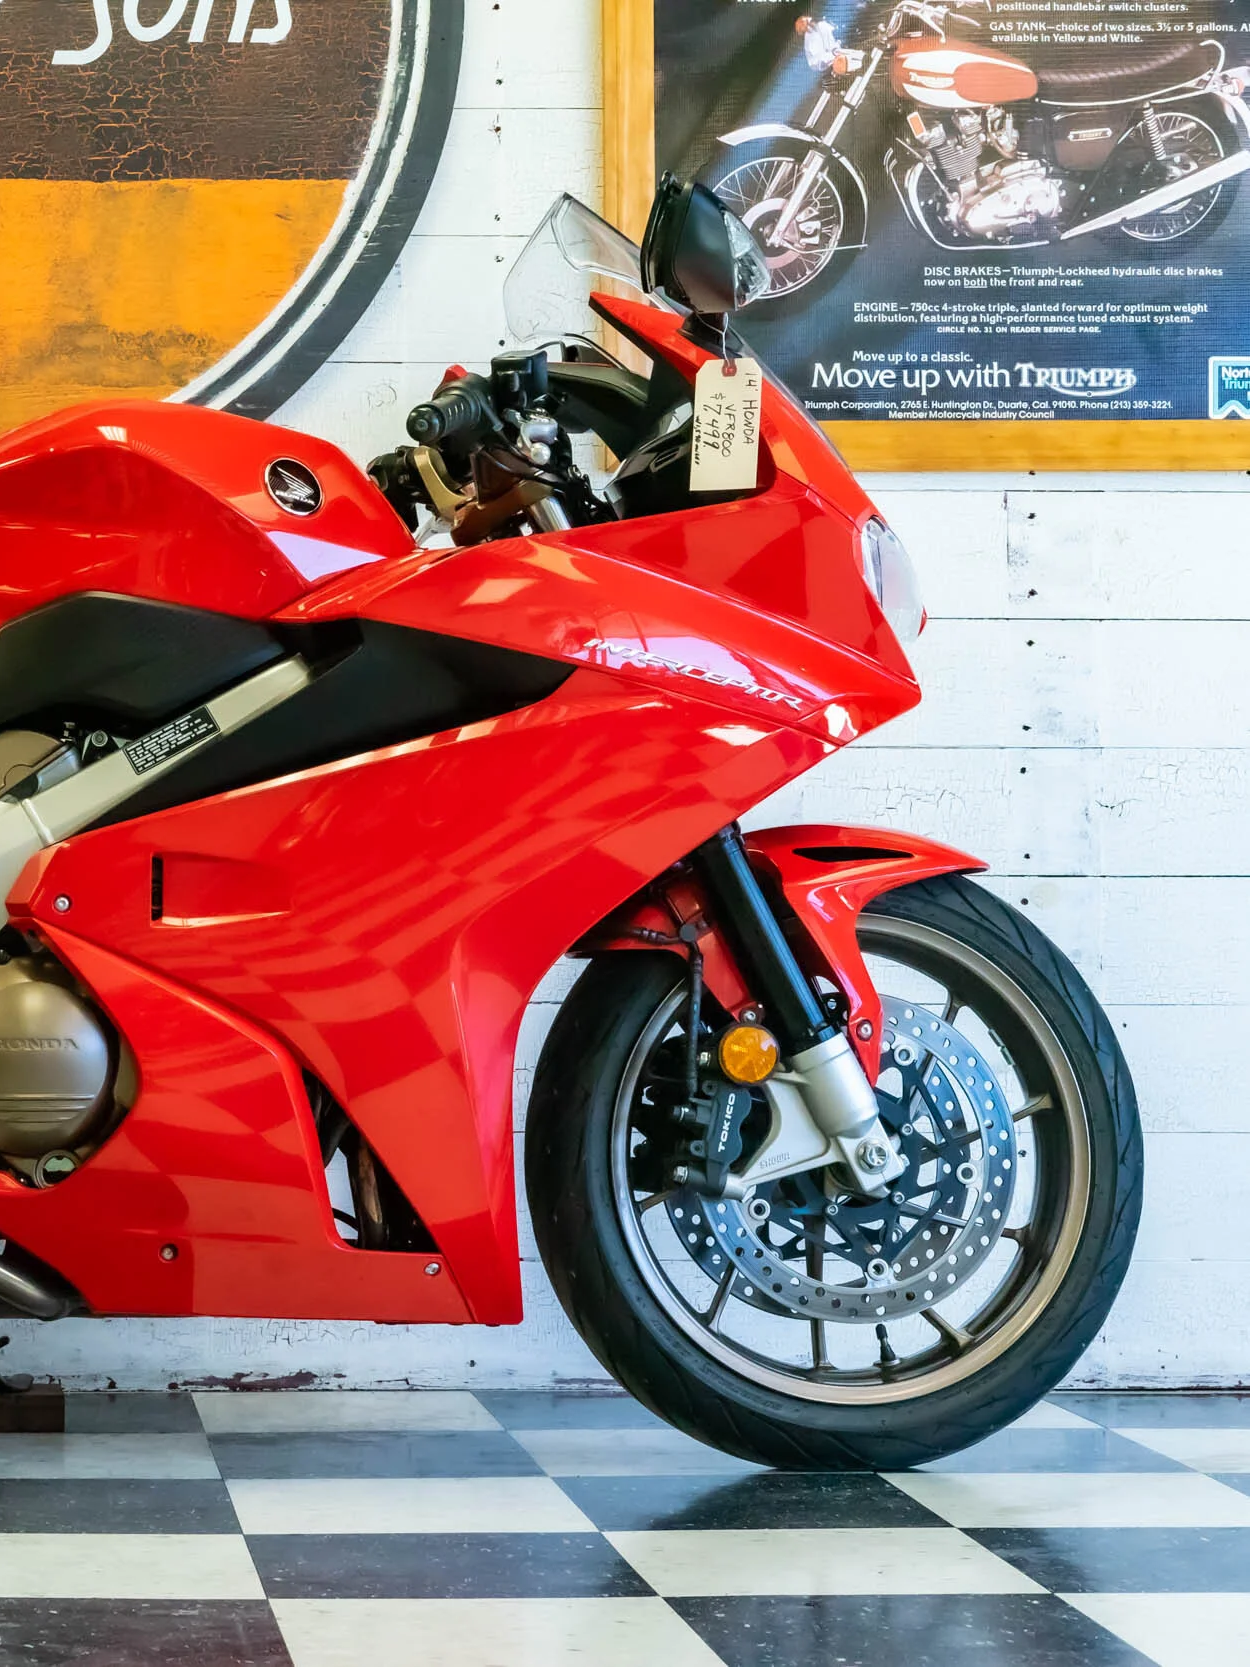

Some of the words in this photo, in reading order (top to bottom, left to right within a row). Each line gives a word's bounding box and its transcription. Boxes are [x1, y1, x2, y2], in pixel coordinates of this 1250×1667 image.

[997, 2, 1050, 12] positioned
[1054, 2, 1105, 11] handlebar
[1109, 2, 1141, 11] switch
[1144, 2, 1188, 11] clusters.
[990, 22, 1013, 31] GAS
[1105, 23, 1124, 32] two
[992, 33, 1038, 42] available
[1053, 34, 1085, 43] Yellow
[1088, 34, 1107, 43] and
[1110, 34, 1143, 43] White.
[925, 267, 950, 276] DISC
[1113, 267, 1161, 277] hydraulic
[1164, 267, 1184, 276] disc
[1187, 267, 1223, 276] brakes
[924, 279, 945, 287] now
[948, 279, 961, 287] on
[964, 278, 987, 288] both
[990, 278, 1006, 287] the
[1009, 277, 1035, 286] front
[1038, 277, 1057, 286] and
[1060, 279, 1084, 287] rear.
[854, 303, 898, 312] ENGINE
[911, 303, 939, 312] 750cc
[988, 303, 1019, 314] triple,
[1021, 303, 1059, 312] slanted
[1062, 303, 1103, 312] forward
[1124, 304, 1171, 314] optimum
[1173, 303, 1208, 314] weight
[854, 313, 917, 322] distribution,
[920, 313, 968, 324] featuring
[980, 314, 1075, 324] high-performance
[1077, 314, 1107, 323] tuned
[1109, 313, 1151, 322] exhaust
[1153, 313, 1193, 324] system.
[937, 326, 964, 334] CIRCLE
[1011, 326, 1040, 334] READER
[1044, 326, 1075, 334] SERVICE
[853, 351, 884, 361] Move
[888, 354, 902, 364] up
[931, 352, 973, 362] classic.
[1221, 366, 1250, 378] Nort
[812, 363, 901, 388] Move
[902, 367, 941, 396] up
[946, 361, 1010, 387] with
[1013, 363, 1136, 397] TRIUMPH
[805, 401, 839, 410] Triumph
[841, 401, 898, 410] Corporation,
[901, 401, 921, 409] 2765
[932, 401, 981, 410] Huntington
[983, 401, 996, 411] Dr.,
[998, 401, 1030, 411] Duarte,
[1032, 401, 1050, 410] Cal.
[1053, 401, 1078, 409] 91010.
[1080, 401, 1109, 410] Phone
[1111, 400, 1131, 409] (213)
[1133, 401, 1173, 409] 359-3221.
[889, 411, 927, 419] Member
[929, 409, 981, 419] Motorcycle
[982, 410, 1017, 420] Industry
[1018, 411, 1054, 419] Council
[742, 399, 758, 445] HONDA
[721, 403, 737, 458] VFR800
[583, 638, 803, 711] INTERCEPTOR
[717, 1092, 736, 1153] TOKICO
